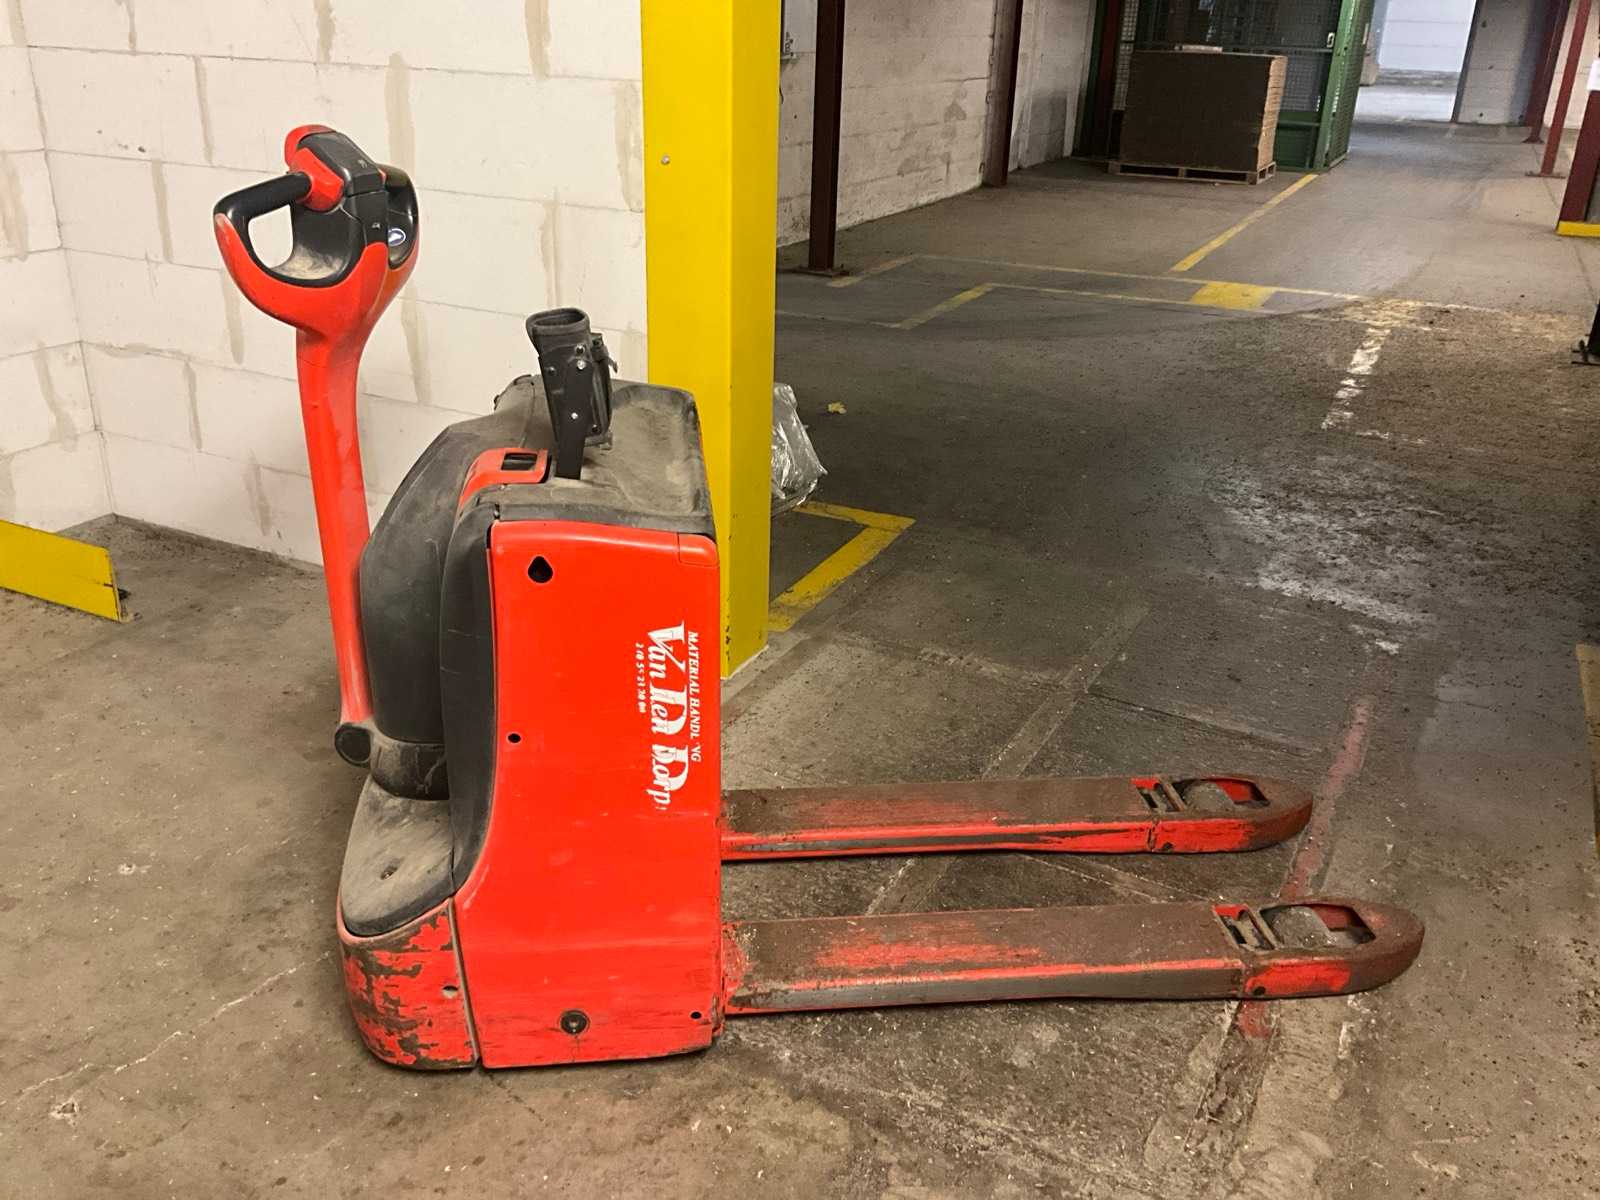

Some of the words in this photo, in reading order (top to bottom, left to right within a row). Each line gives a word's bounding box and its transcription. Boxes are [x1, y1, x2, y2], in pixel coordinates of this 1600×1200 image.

[647, 620, 687, 679] Van
[687, 630, 700, 696] MATERIAL
[688, 697, 702, 763] HANDLNG
